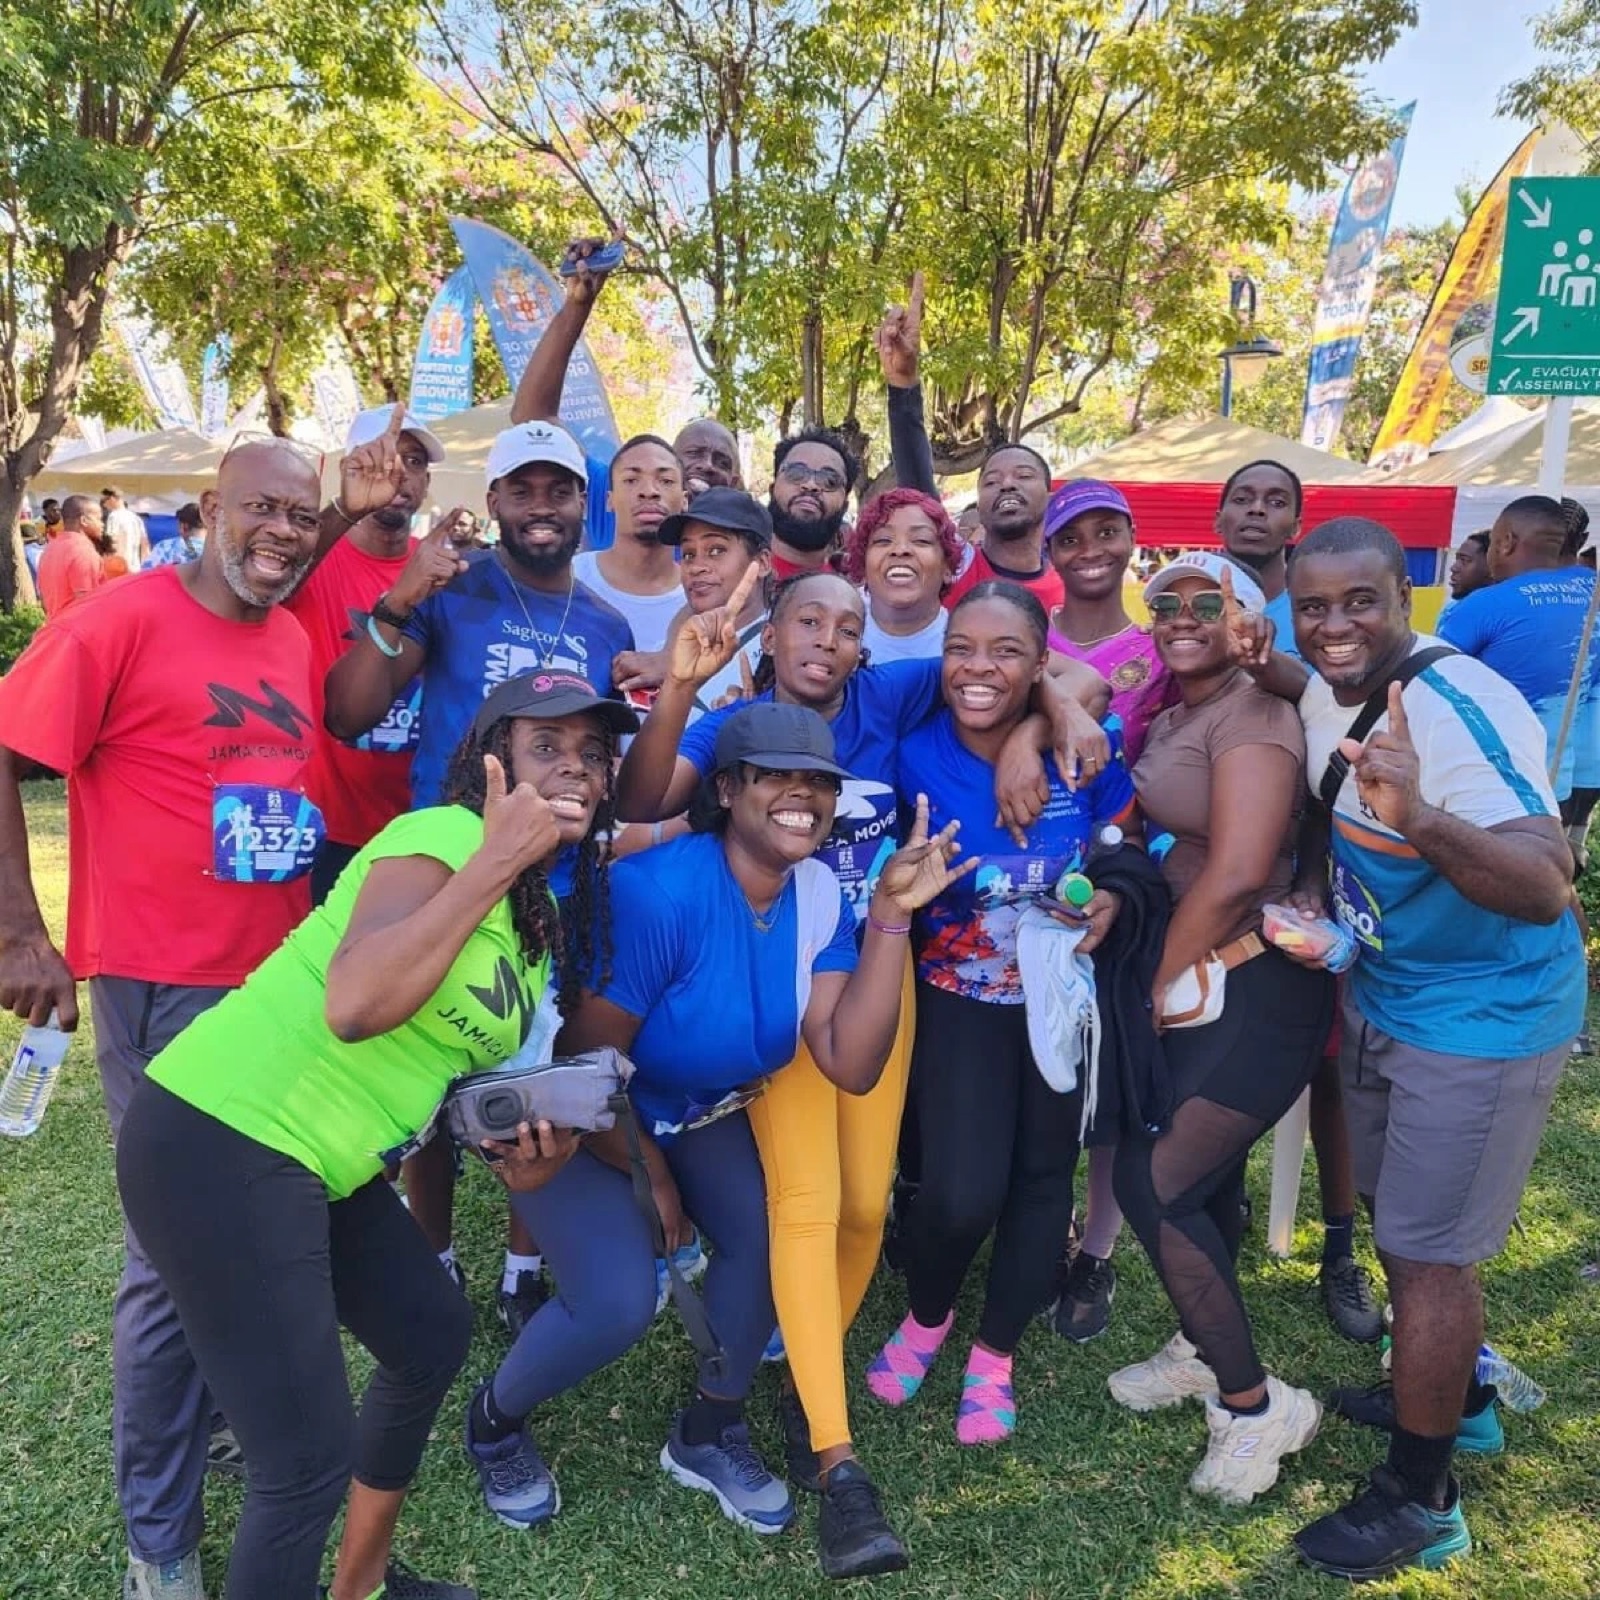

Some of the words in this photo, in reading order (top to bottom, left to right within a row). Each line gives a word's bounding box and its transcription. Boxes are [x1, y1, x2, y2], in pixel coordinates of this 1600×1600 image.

[454, 364, 470, 374] OF
[415, 374, 468, 387] ECONOMIC
[1513, 380, 1590, 390] ASSEMBLY
[414, 384, 469, 401] GROWTH
[502, 619, 559, 645] Sagicor
[208, 746, 279, 760] JAMAICA
[236, 826, 316, 852] 12323
